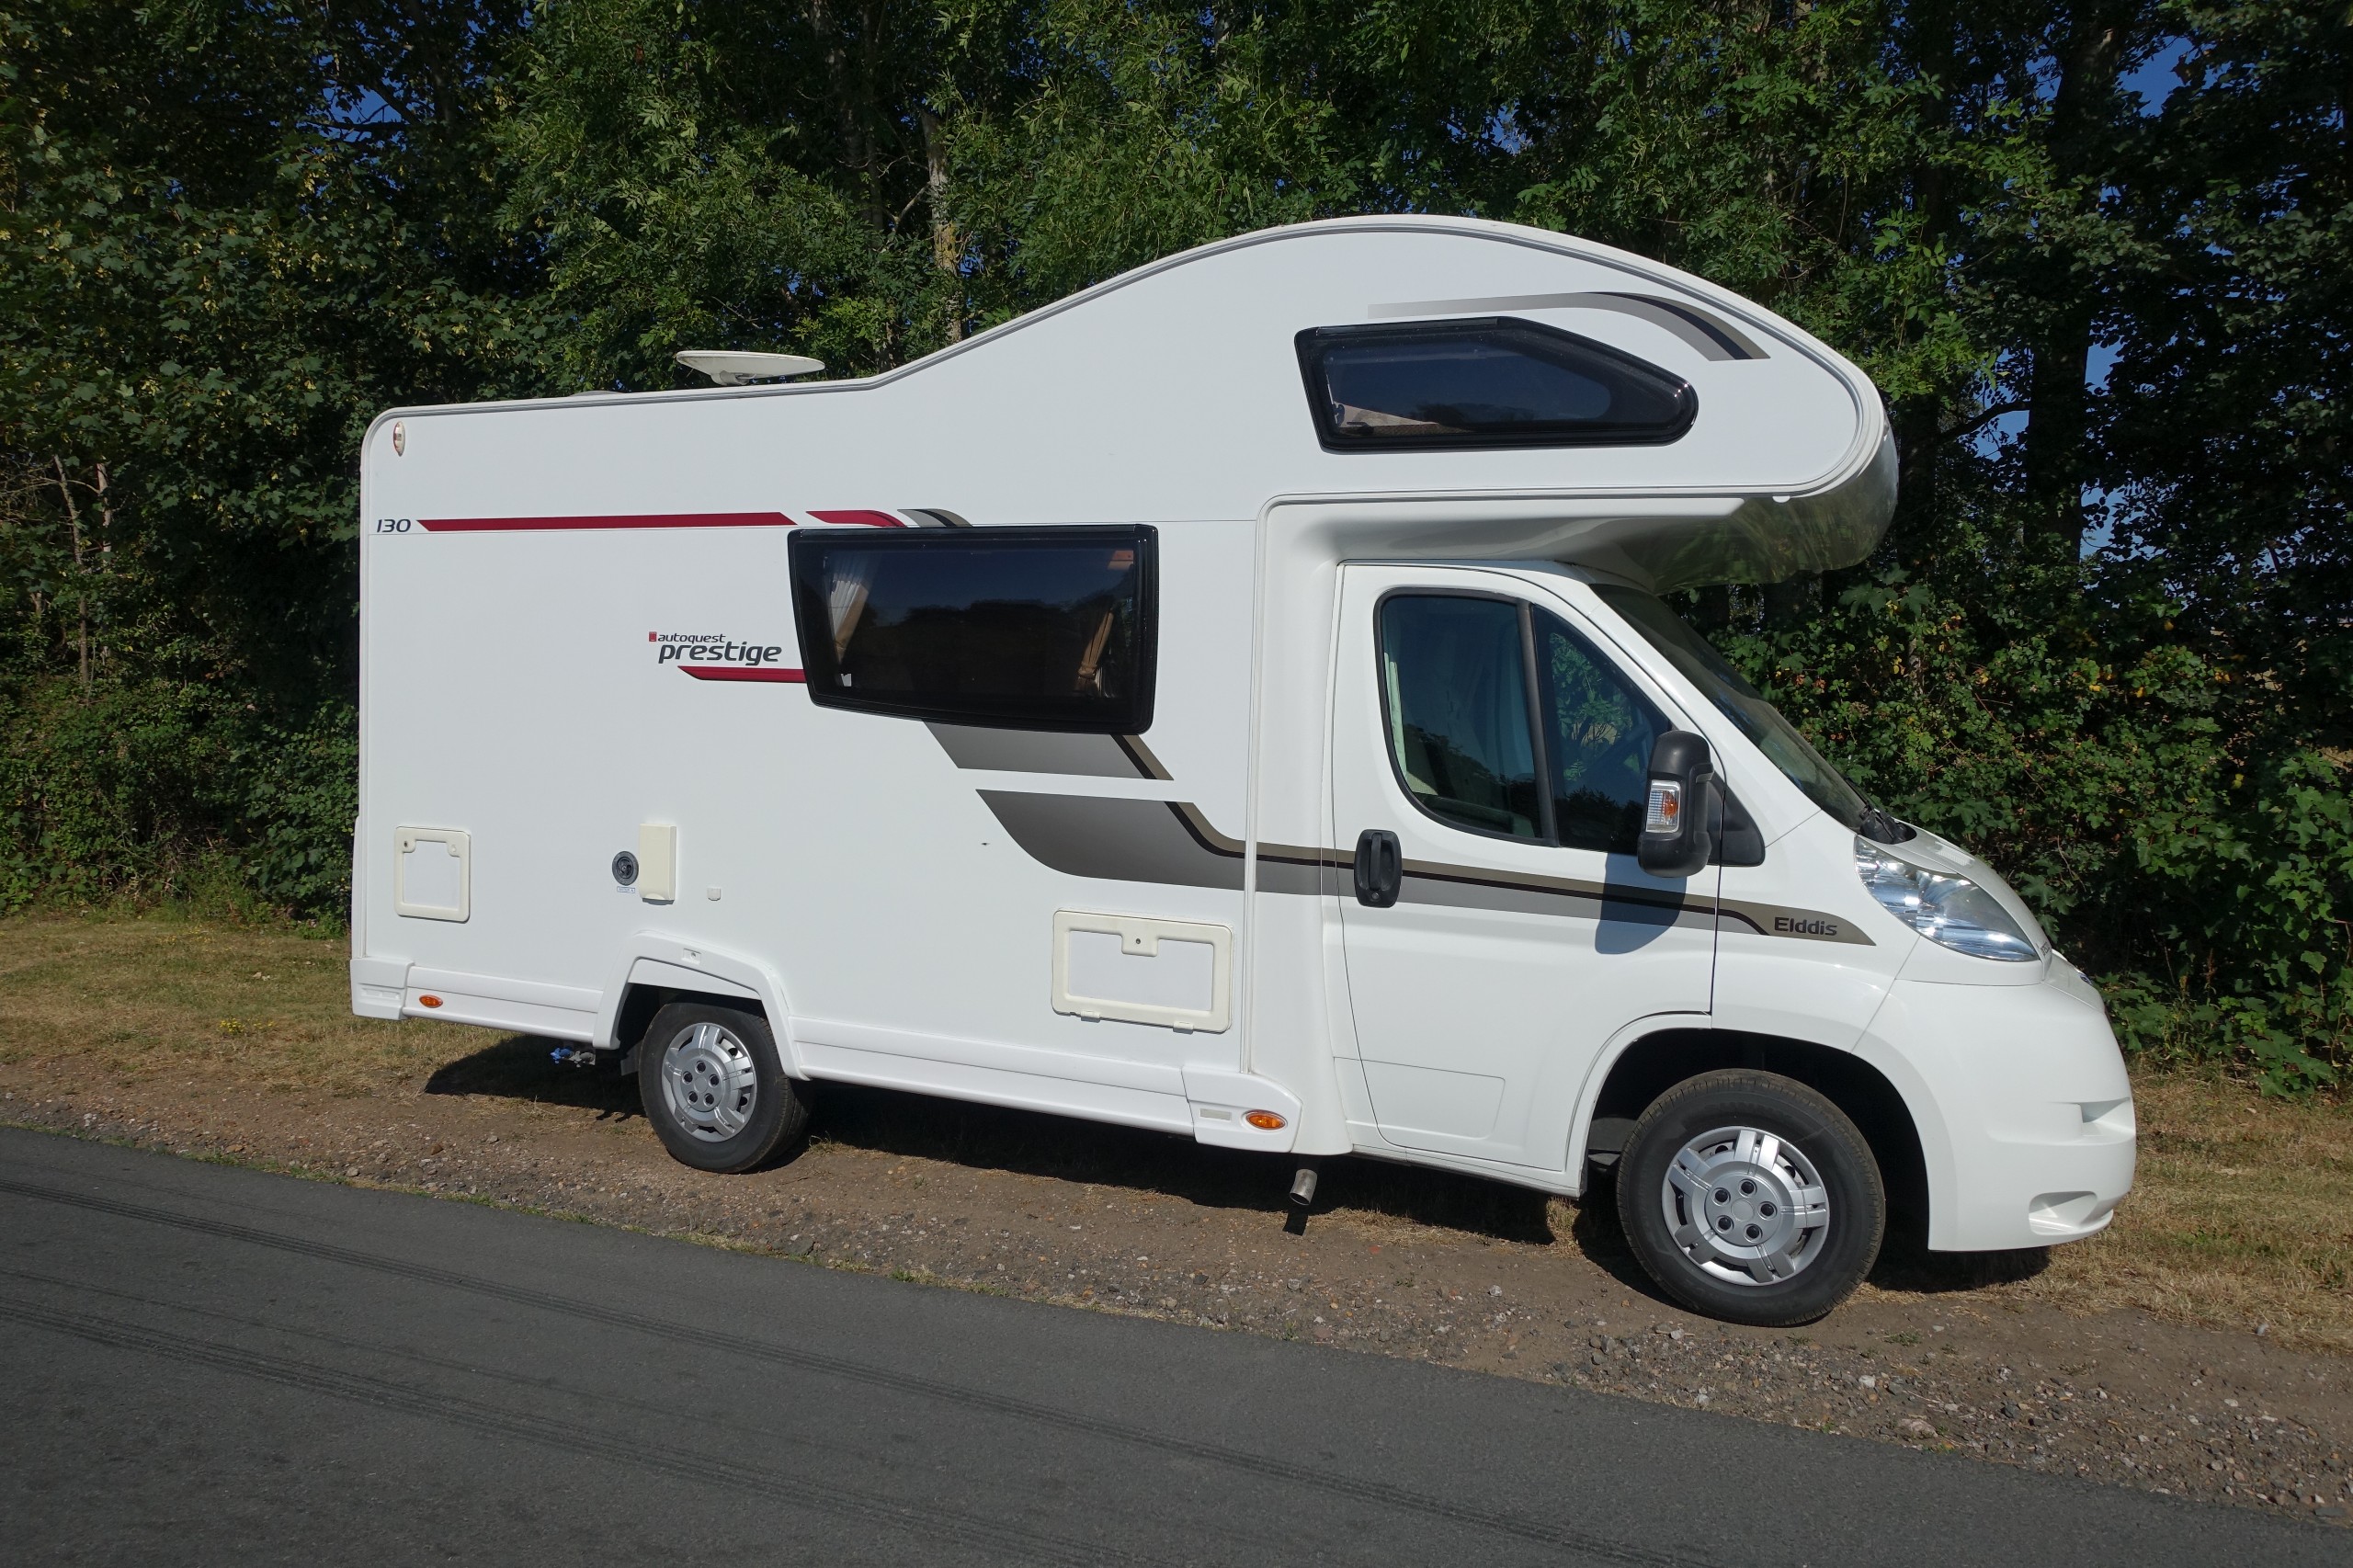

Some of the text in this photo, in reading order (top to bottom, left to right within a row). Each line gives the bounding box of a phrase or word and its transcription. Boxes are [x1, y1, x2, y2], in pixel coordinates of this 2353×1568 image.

[376, 518, 412, 533] 130
[657, 632, 726, 644] autoquest
[658, 641, 782, 666] prestige
[1774, 916, 1837, 936] Elddis
